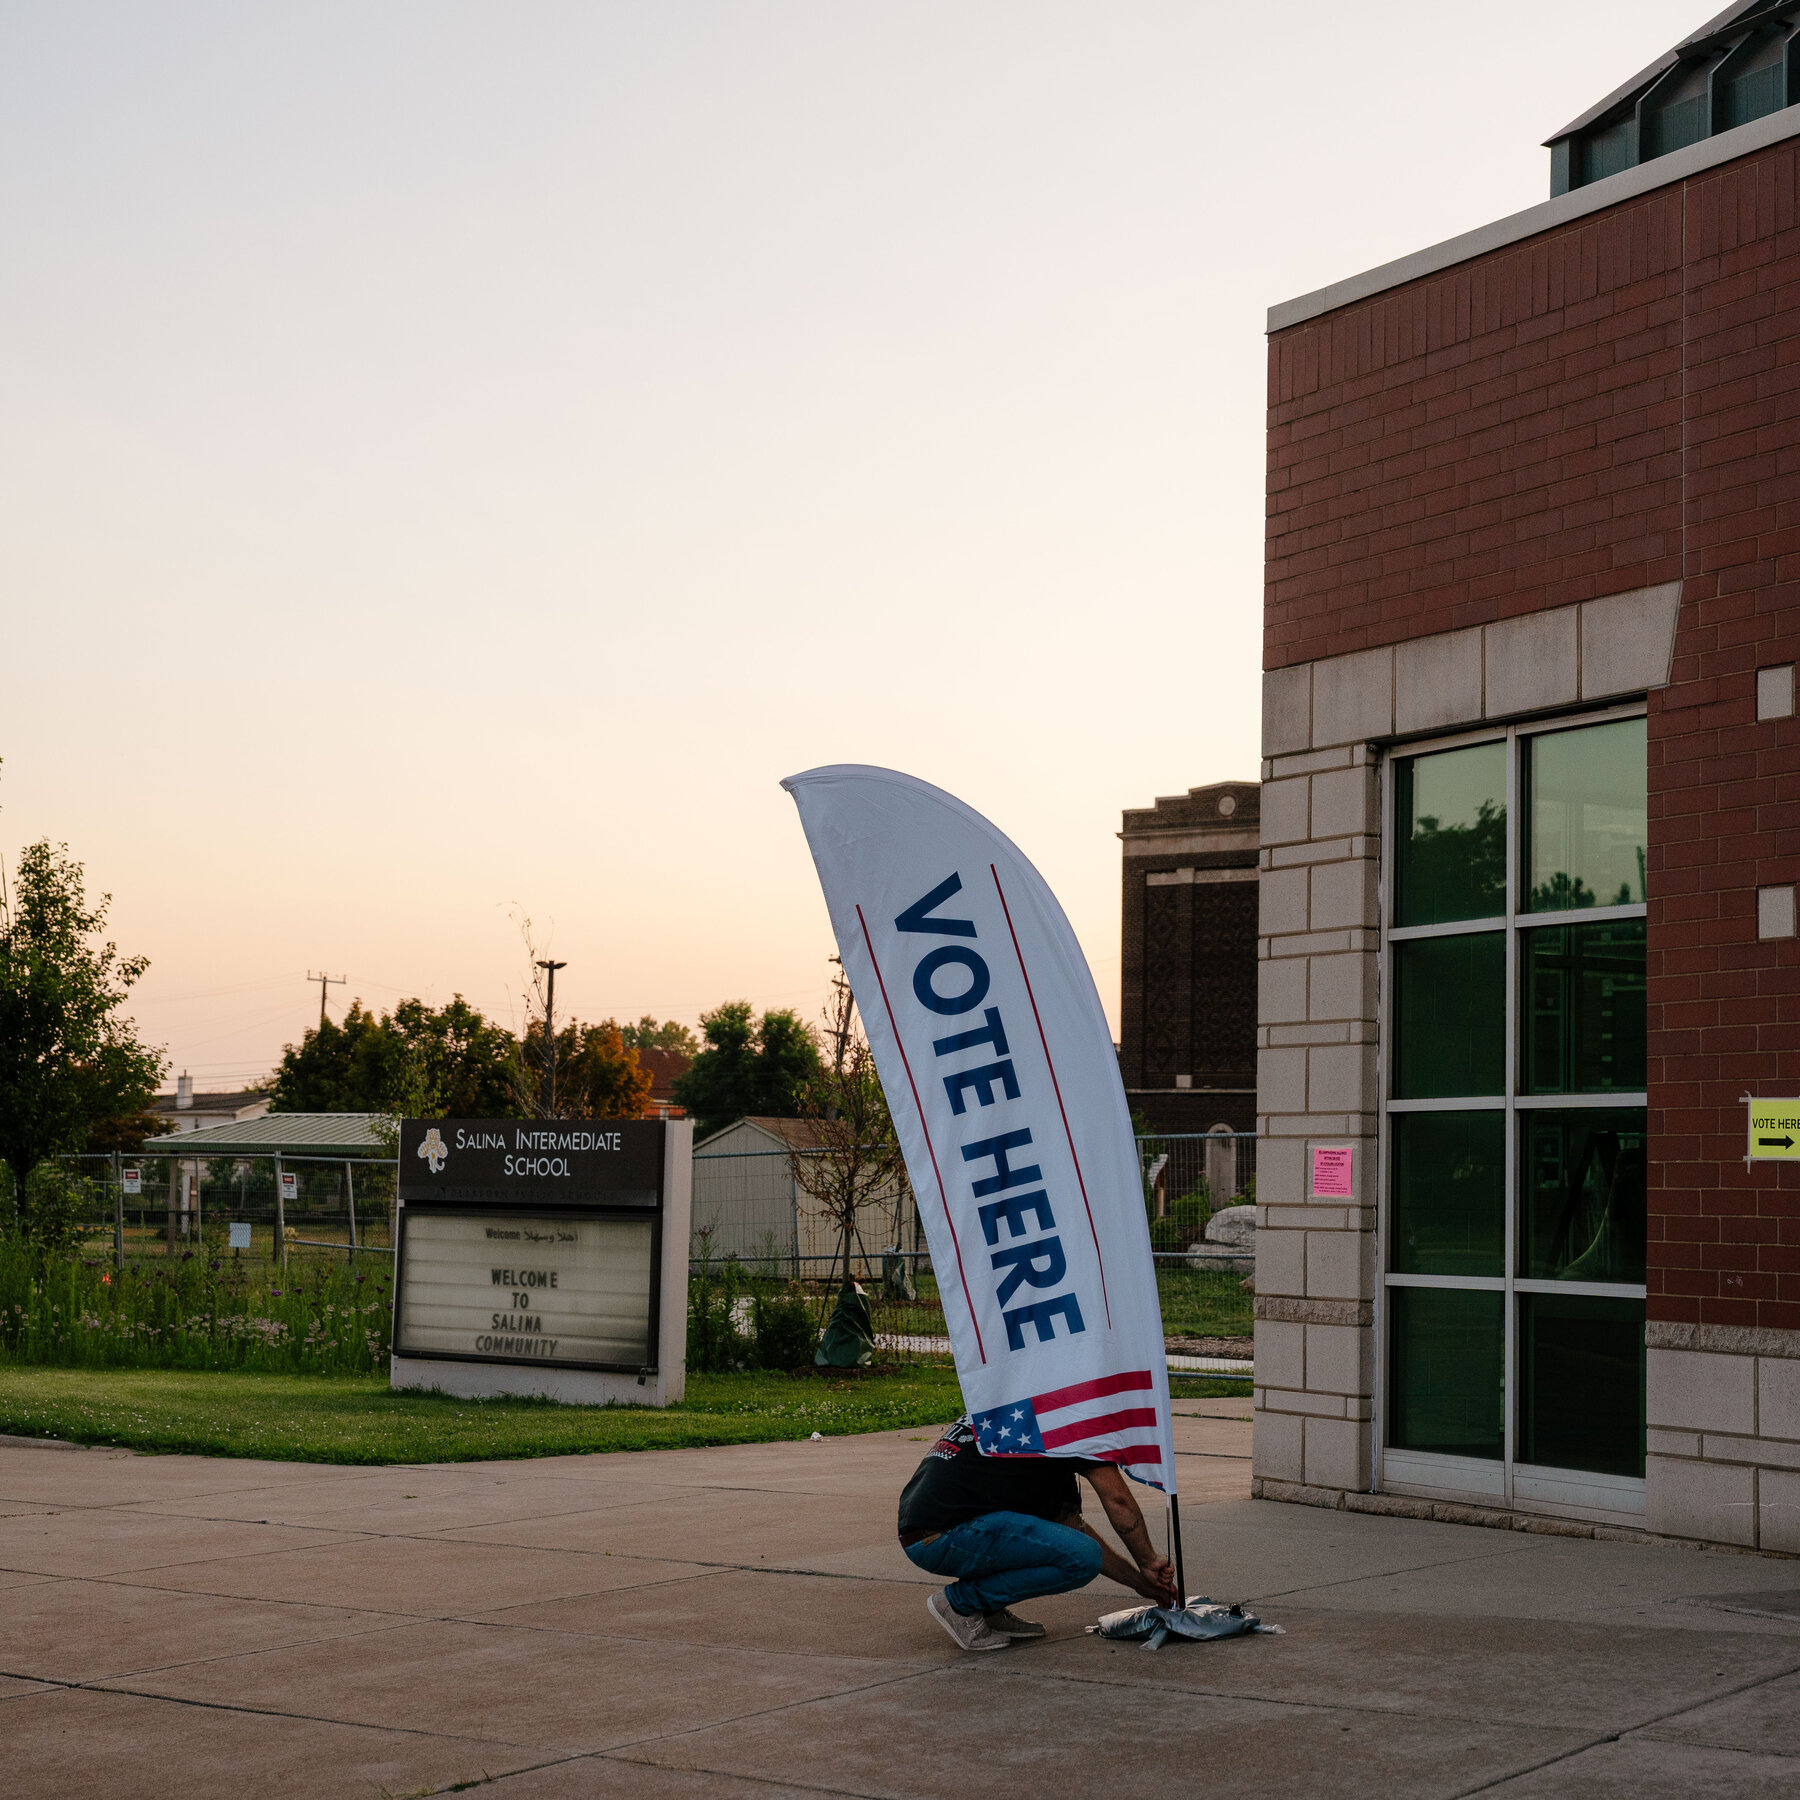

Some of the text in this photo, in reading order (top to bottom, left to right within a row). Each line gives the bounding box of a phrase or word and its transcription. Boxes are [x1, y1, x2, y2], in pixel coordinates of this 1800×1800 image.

[894, 871, 1086, 1352] VOTE HERE
[1752, 1118, 1775, 1129] VOTE
[456, 1128, 621, 1151] SALINA INTERMEDIATE
[504, 1154, 571, 1177] SCHOOL
[486, 1228, 520, 1240] Welcome
[491, 1269, 558, 1288] WELCOME
[512, 1292, 529, 1309] TO
[491, 1313, 541, 1332] SALINA
[475, 1335, 558, 1356] COMMUNITY
